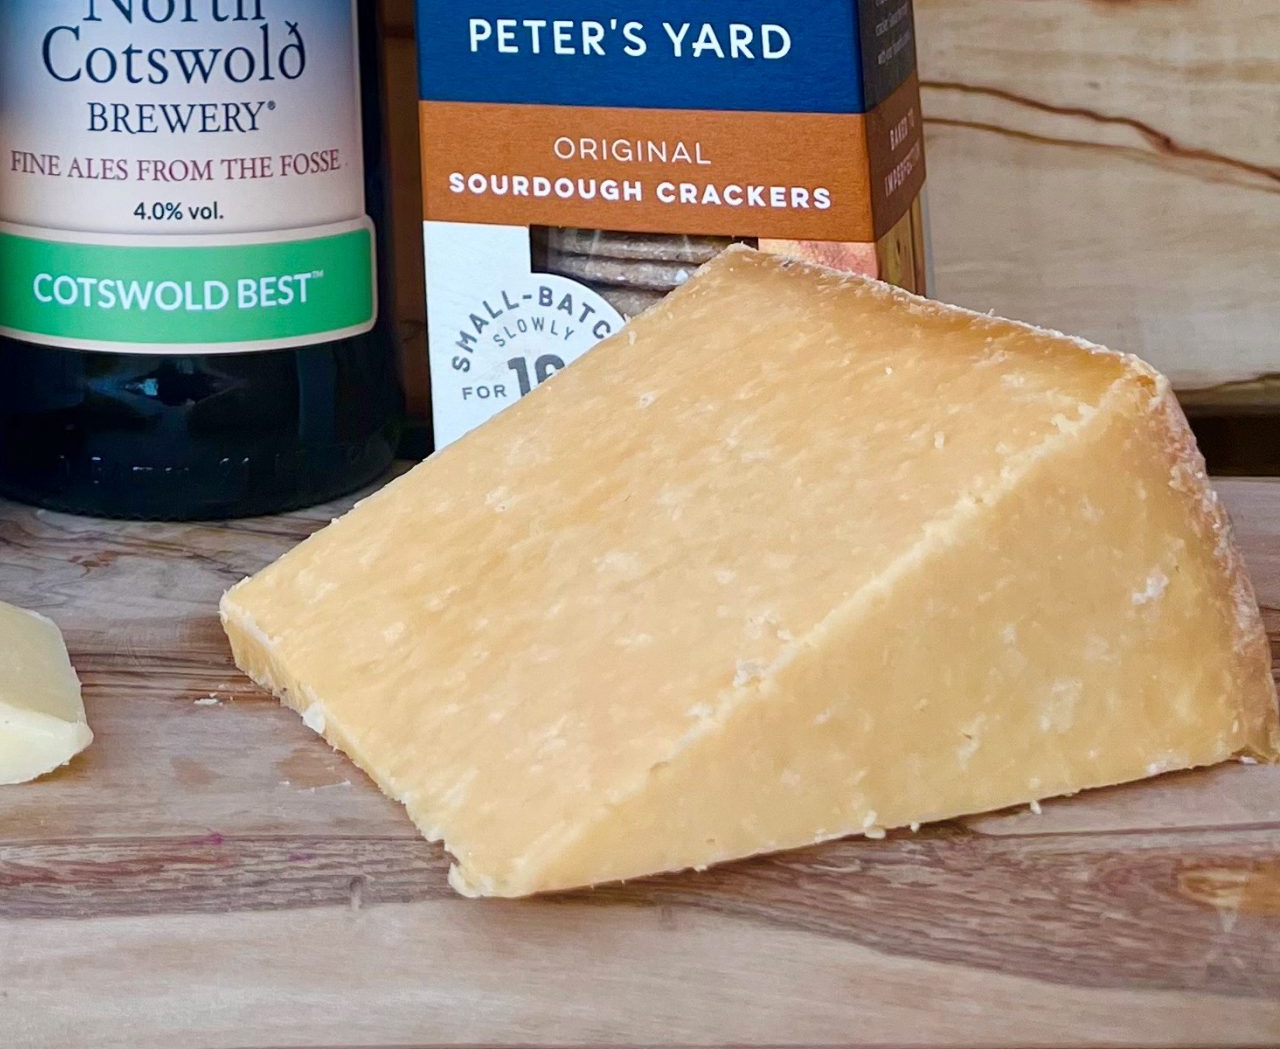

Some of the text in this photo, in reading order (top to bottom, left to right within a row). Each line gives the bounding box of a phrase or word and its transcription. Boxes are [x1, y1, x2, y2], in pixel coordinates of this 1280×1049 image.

[468, 18, 793, 60] PETER'S YARD
[10, 149, 341, 183] FINE ALES FROM THE FOSSE
[552, 136, 712, 166] ORIGINAL
[448, 171, 832, 210] SOURDOUGH CRACKERS
[133, 201, 224, 221] 4.0% vol.
[33, 273, 229, 312] COTSWOLD
[451, 286, 613, 374] SMALL-BATC
[493, 315, 575, 348] SLOWLY
[462, 384, 507, 400] FOR
